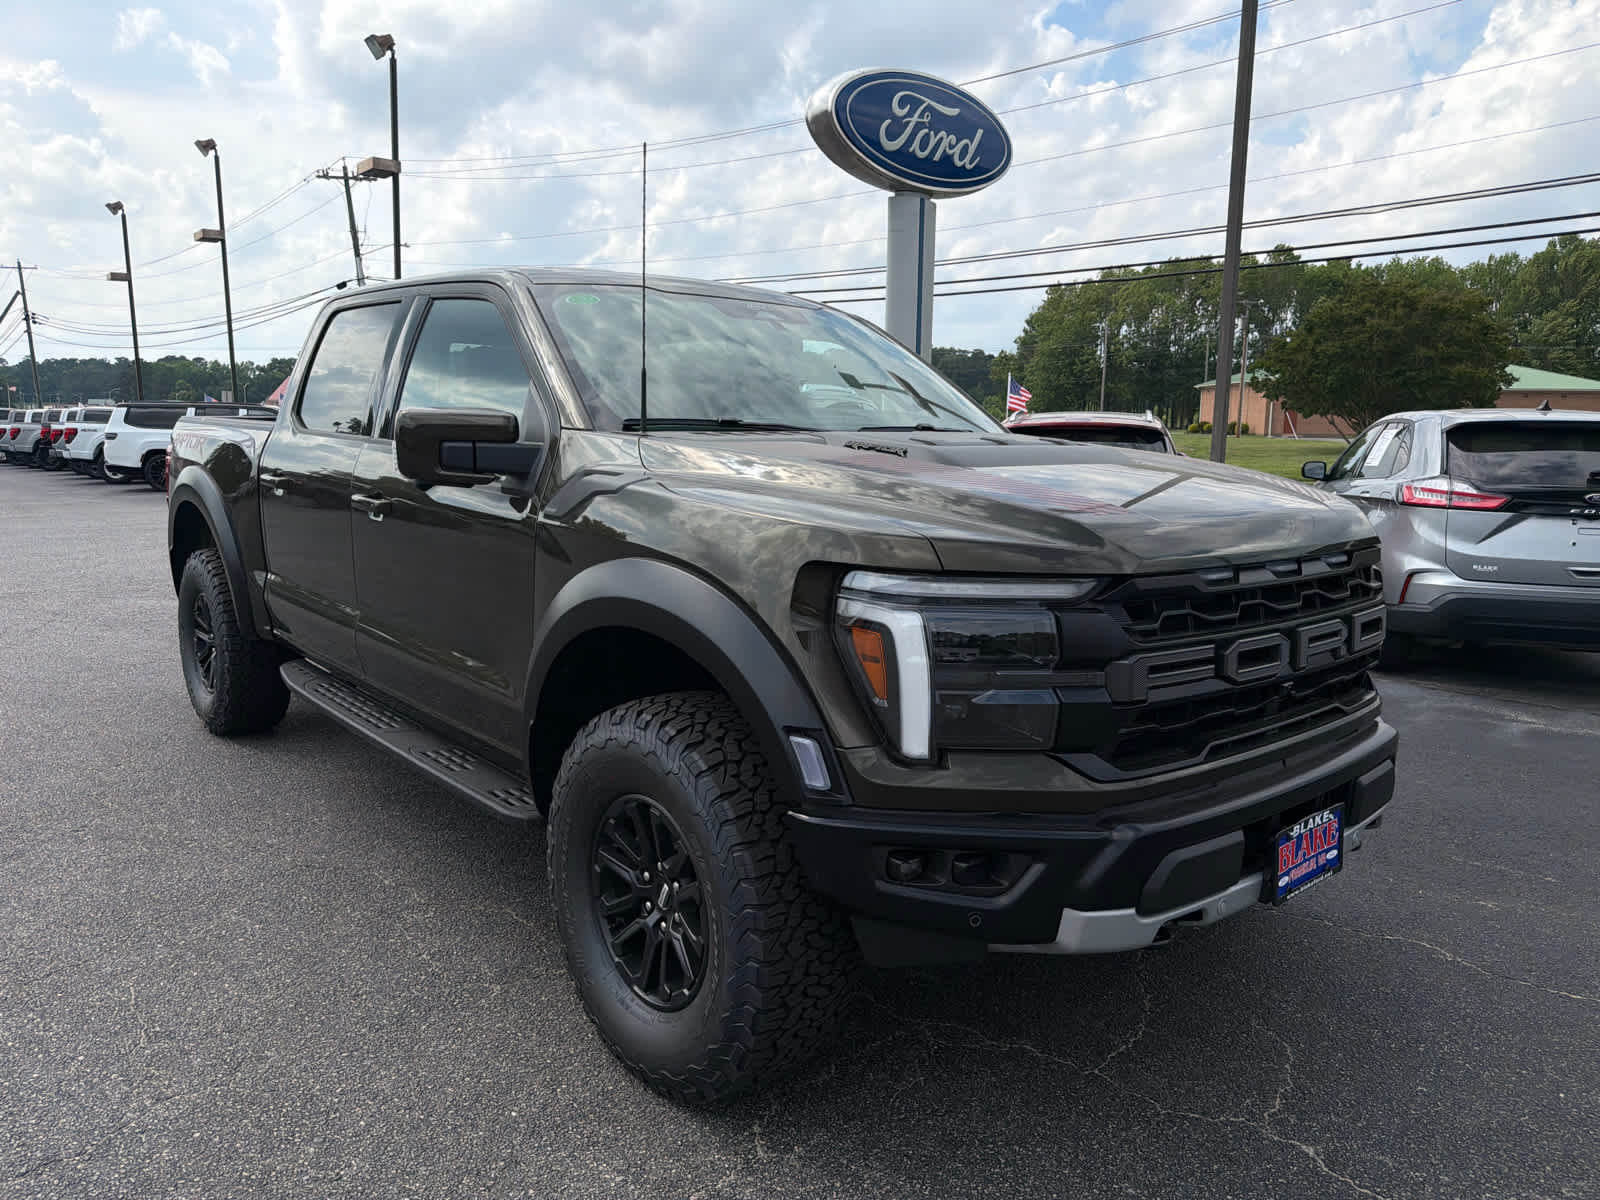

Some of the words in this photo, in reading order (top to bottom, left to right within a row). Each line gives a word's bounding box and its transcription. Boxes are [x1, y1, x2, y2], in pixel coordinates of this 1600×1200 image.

[879, 91, 984, 170] Ford
[1103, 604, 1387, 703] FORD
[1279, 819, 1338, 874] BLAKE
[1292, 810, 1331, 837] BLAKE
